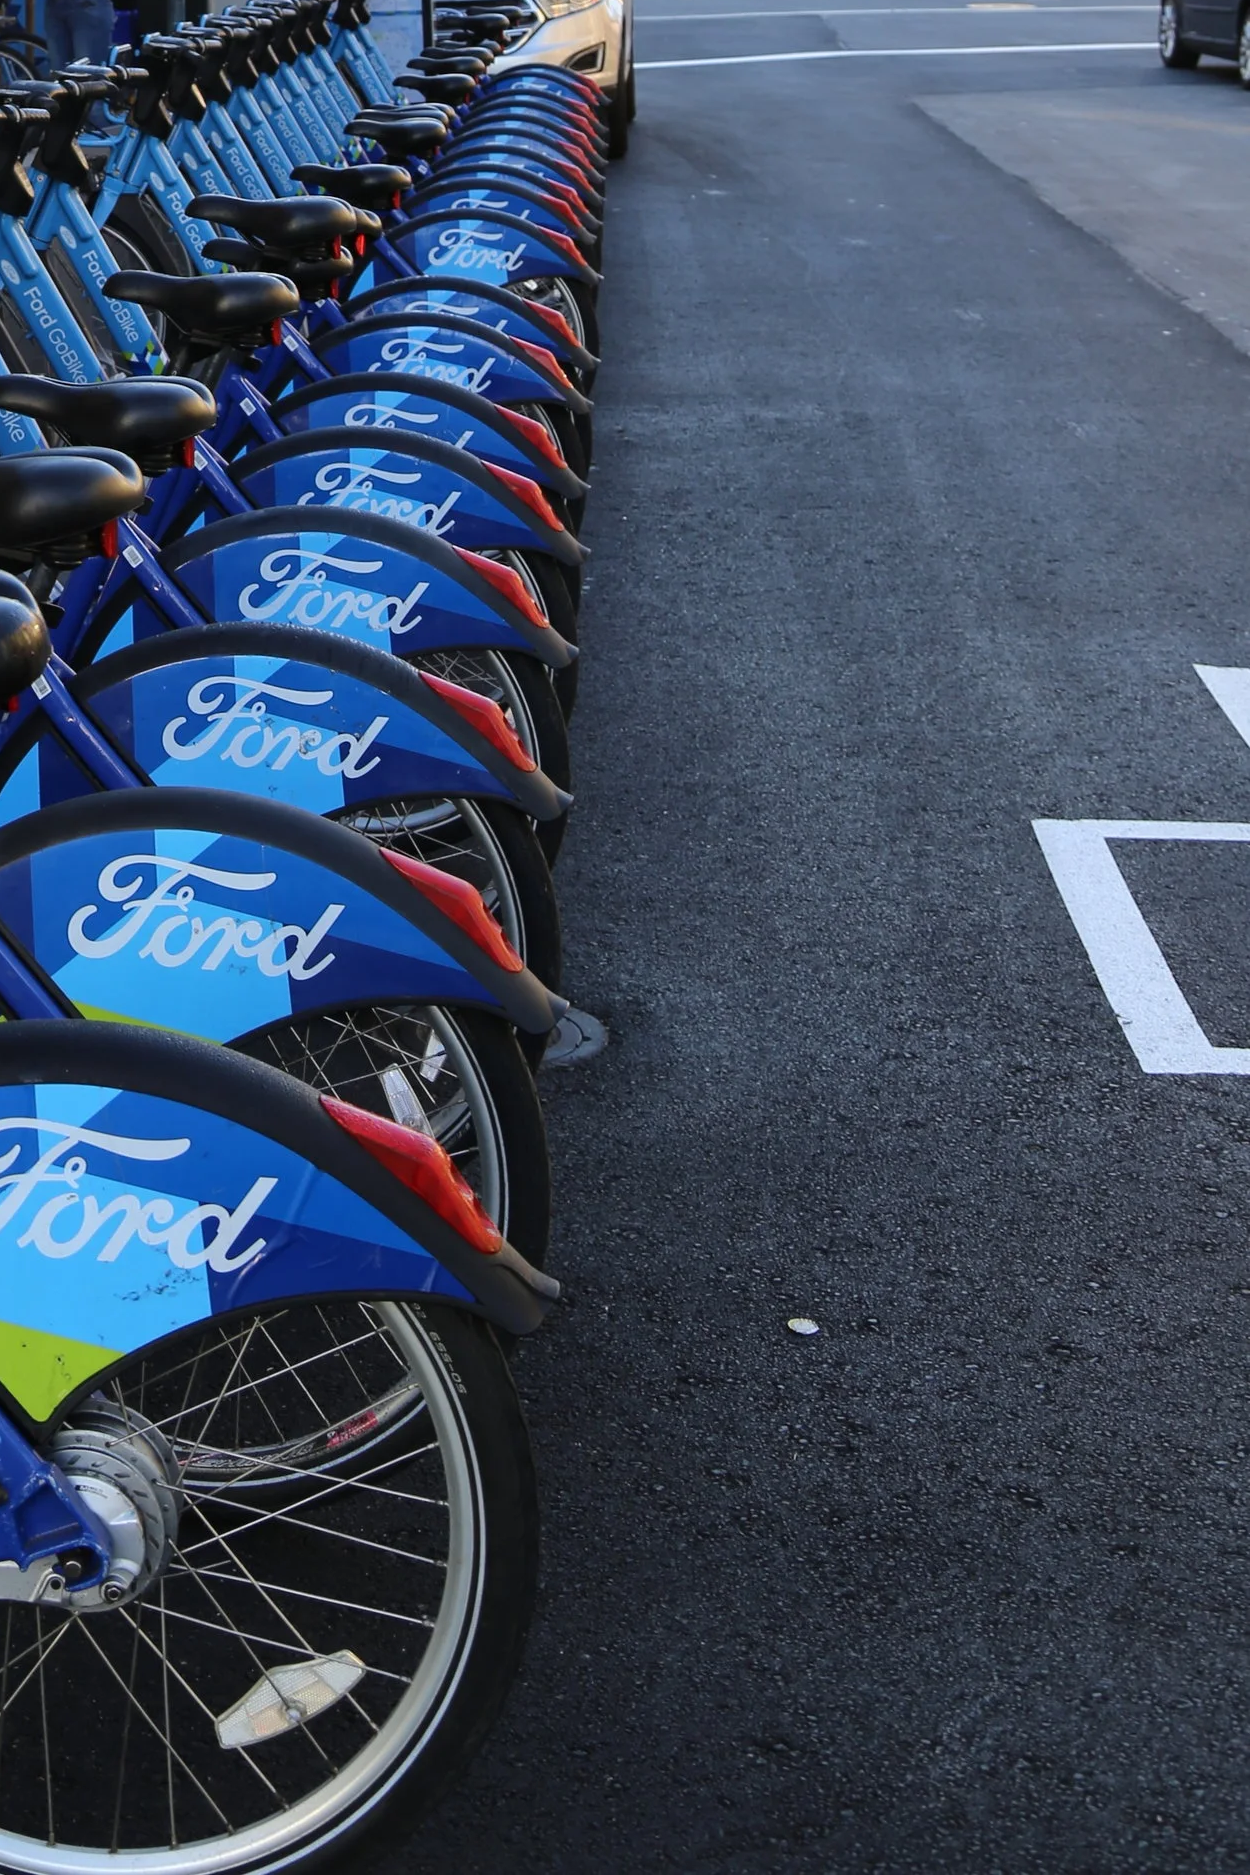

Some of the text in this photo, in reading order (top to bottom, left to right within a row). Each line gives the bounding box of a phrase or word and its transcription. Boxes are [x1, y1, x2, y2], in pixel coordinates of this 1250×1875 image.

[274, 113, 293, 139] Ford
[295, 100, 313, 125] Ford
[226, 147, 248, 178] Ford
[253, 129, 294, 192] Ford GoBike
[167, 191, 193, 225] Ford
[428, 228, 527, 272] Ford
[23, 286, 88, 384] Ford GoBike
[238, 549, 431, 635] Ford
[161, 674, 390, 780] Ford
[67, 854, 345, 981] Ford
[429, 1331, 467, 1394] 50-559
